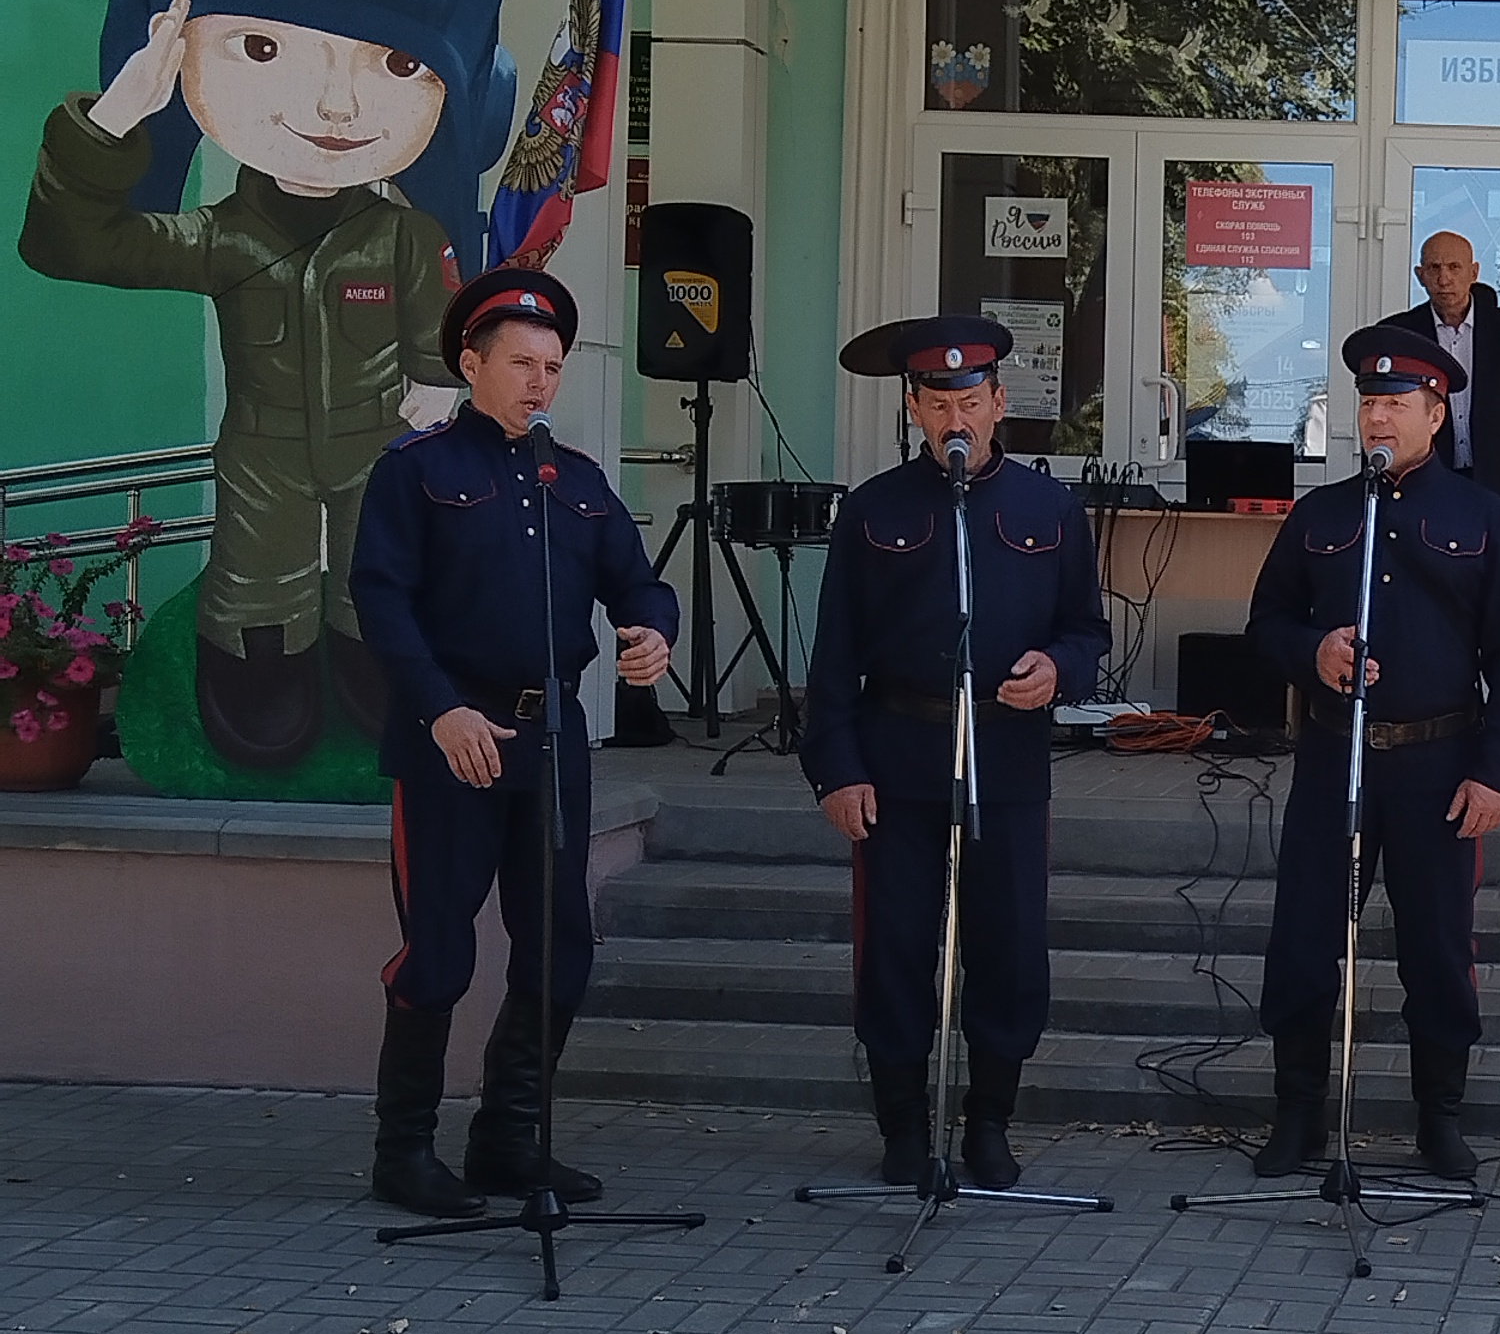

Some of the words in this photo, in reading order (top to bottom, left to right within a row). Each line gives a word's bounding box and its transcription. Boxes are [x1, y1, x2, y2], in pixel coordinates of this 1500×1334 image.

[1192, 186, 1243, 198] ТЕЛЕФОНЫ
[1232, 200, 1265, 210] СЛУЖБ
[1006, 205, 1025, 229] Я
[991, 218, 1062, 251] Россию
[345, 287, 385, 300] АЛЕКСЕЙ
[668, 284, 713, 301] 1000
[1275, 355, 1294, 375] 14
[1250, 388, 1295, 410] 2025
